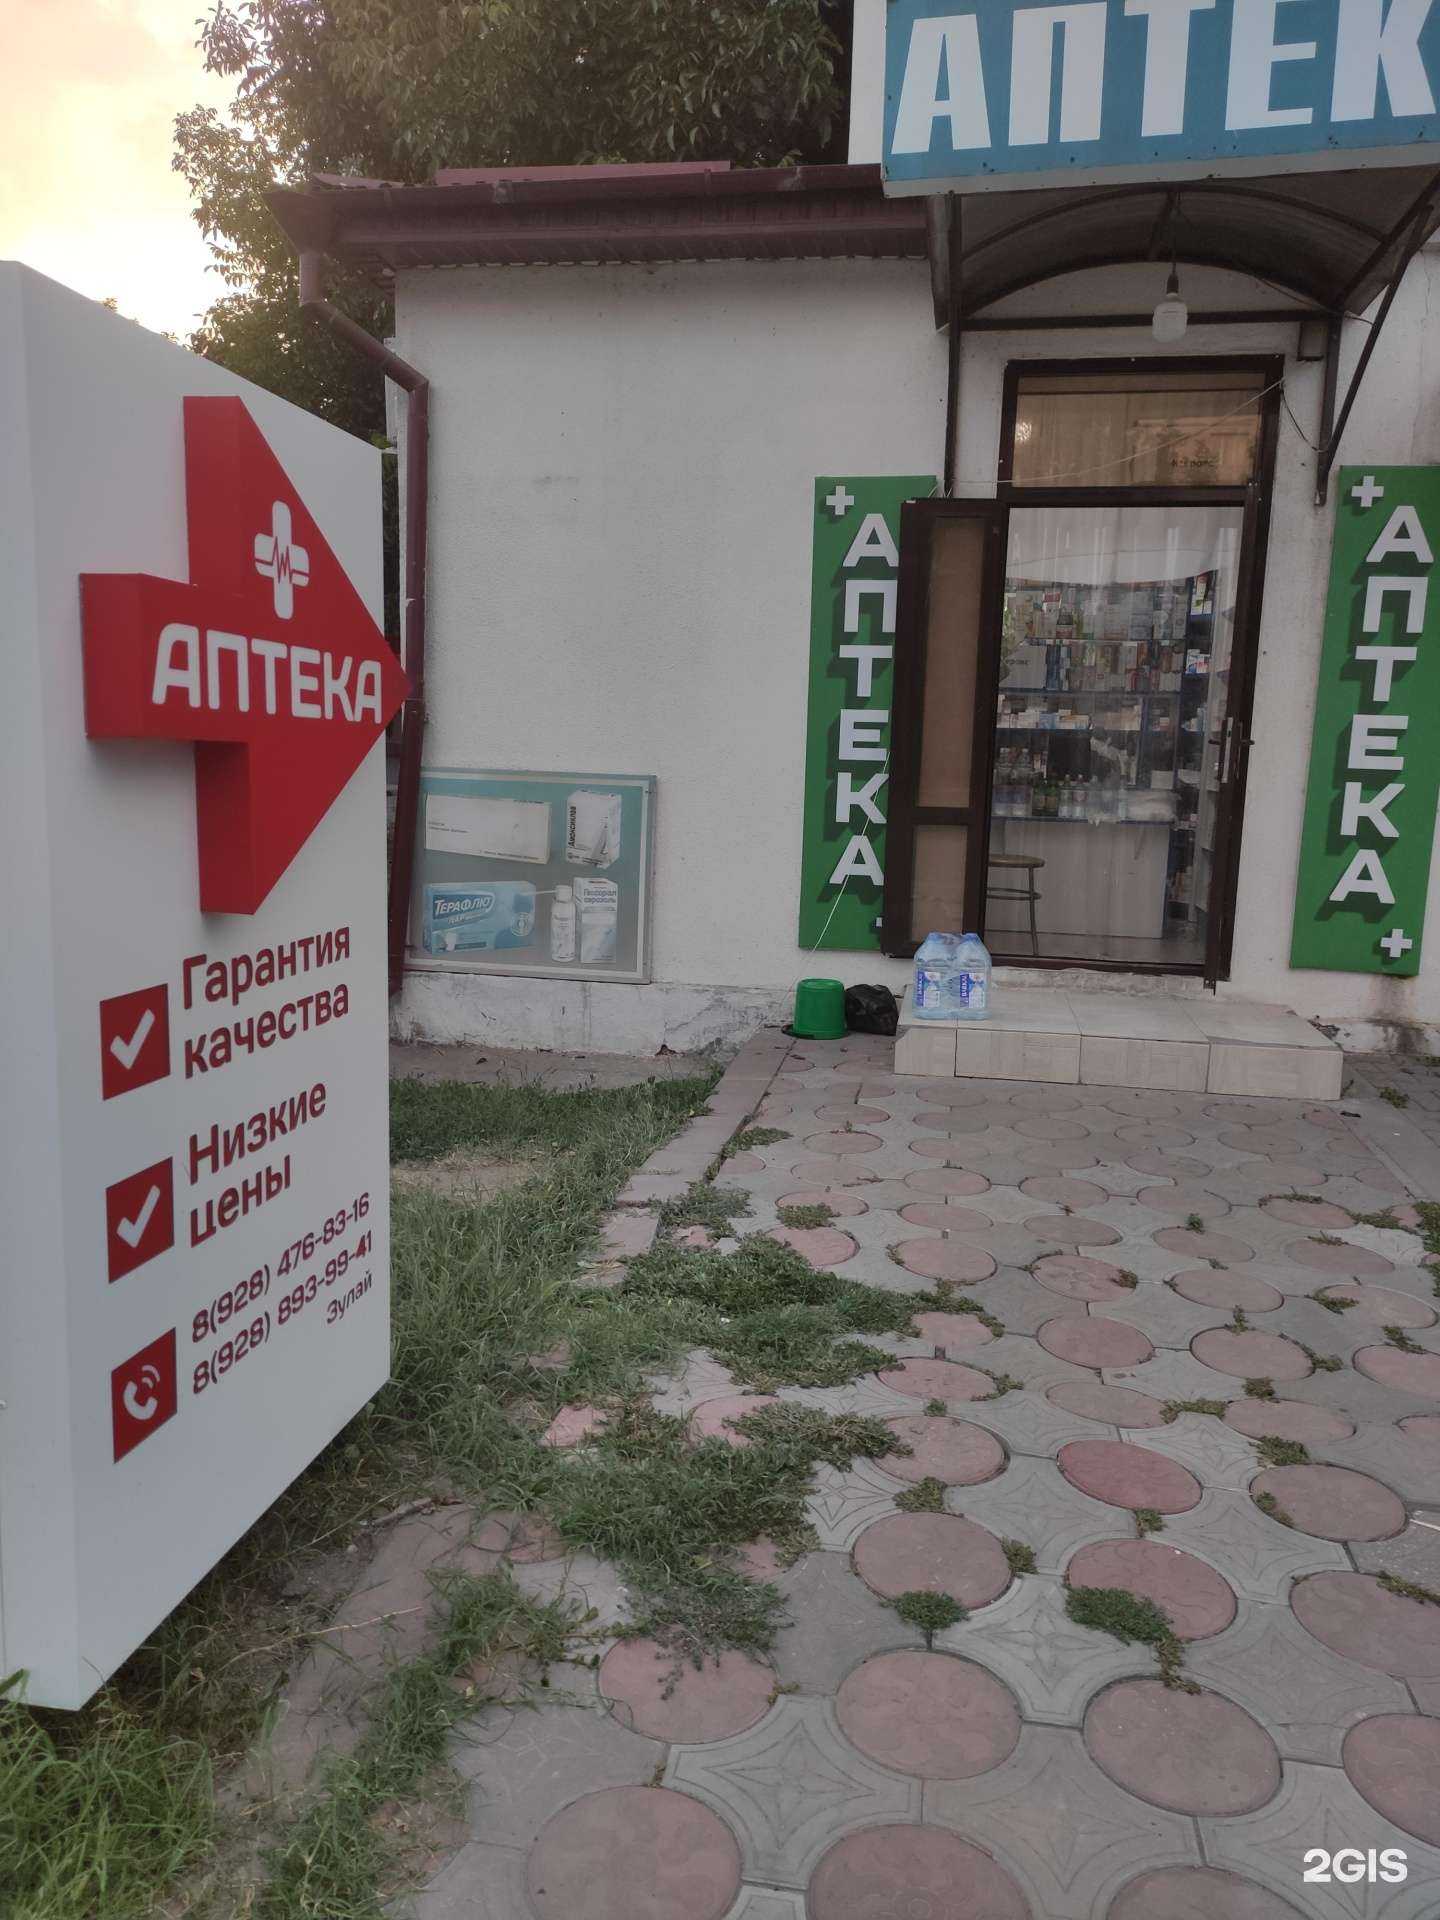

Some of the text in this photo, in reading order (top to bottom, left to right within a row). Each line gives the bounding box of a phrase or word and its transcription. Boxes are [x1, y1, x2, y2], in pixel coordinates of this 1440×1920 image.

[890, 0, 1438, 154] АПТЕК
[152, 623, 382, 724] АПТЕКА
[829, 513, 899, 885] АПТЕКА
[1329, 506, 1434, 904] АПТЕКА
[183, 926, 350, 1010] Гарантия
[184, 983, 349, 1079] качества
[189, 1083, 326, 1185] Низкие
[190, 1155, 292, 1248] цены
[192, 1192, 370, 1343] 8(928) 476-83-16
[193, 1230, 372, 1394] 8(928) 893-99-41
[326, 1269, 372, 1324] Зулай
